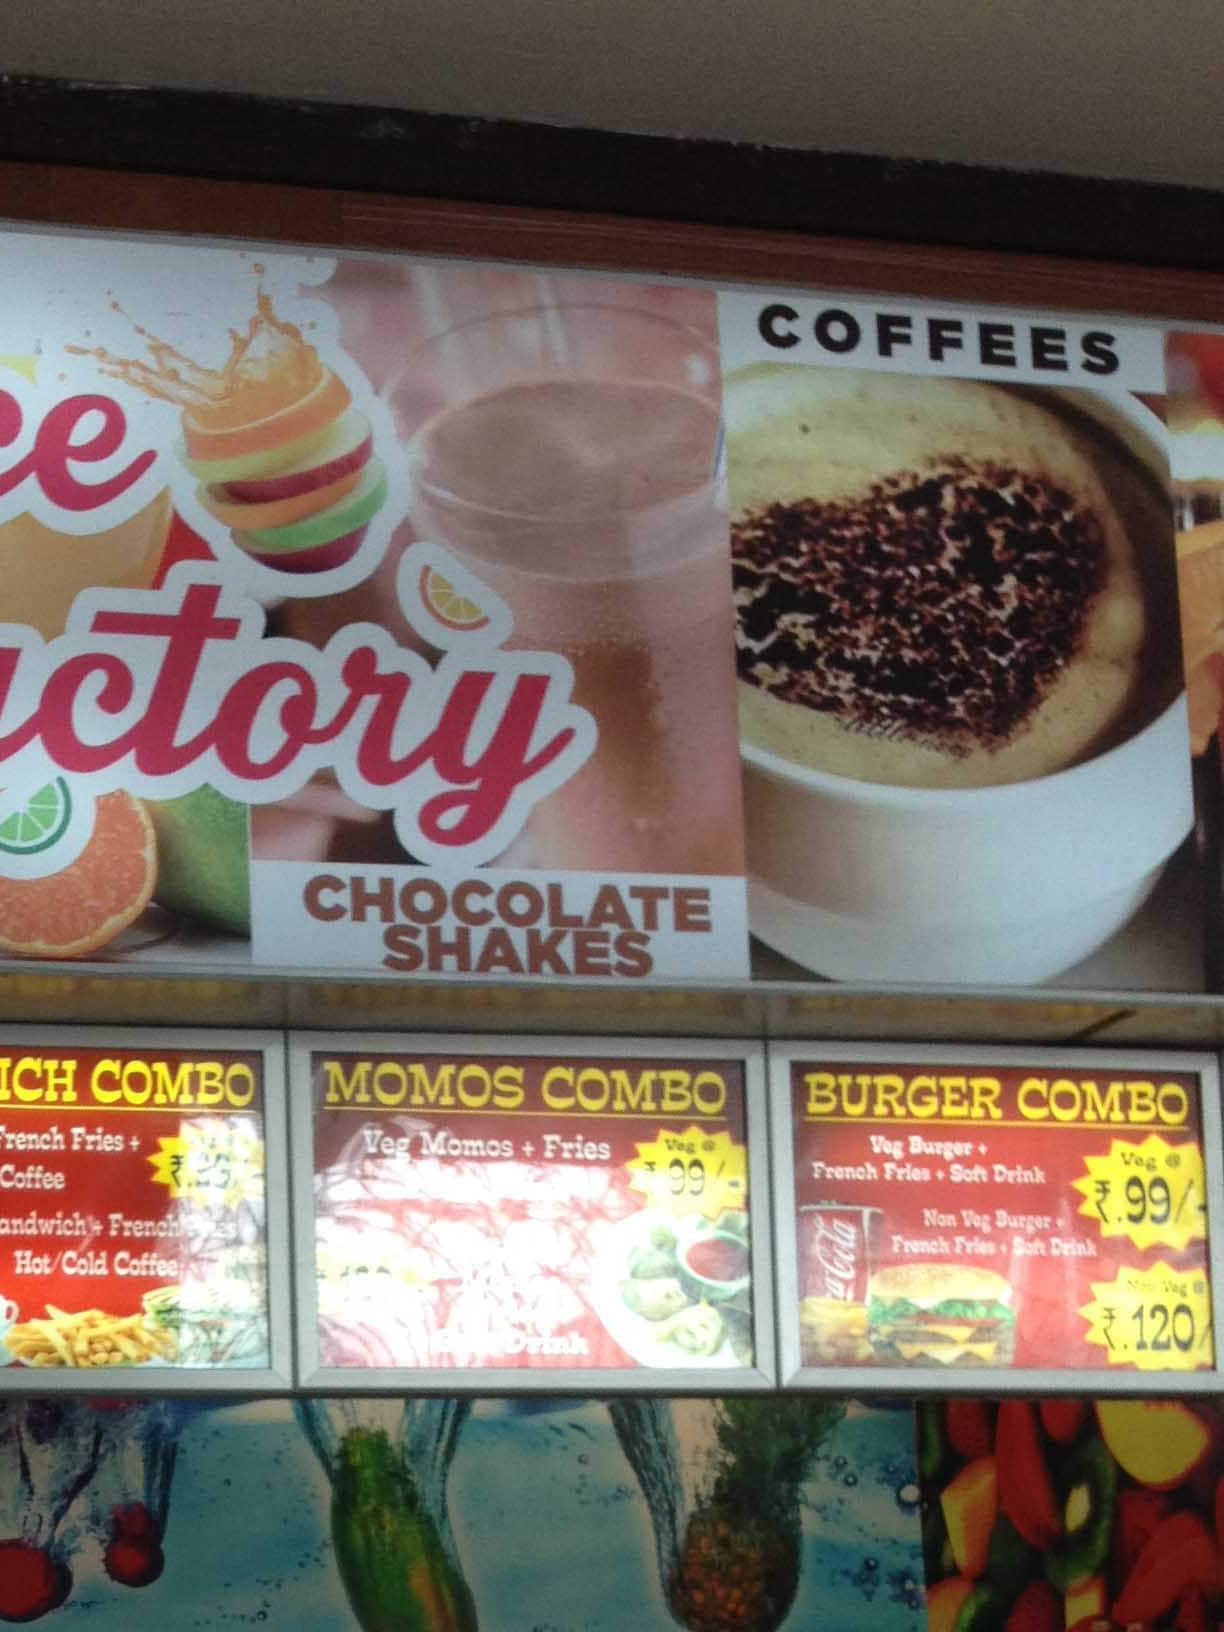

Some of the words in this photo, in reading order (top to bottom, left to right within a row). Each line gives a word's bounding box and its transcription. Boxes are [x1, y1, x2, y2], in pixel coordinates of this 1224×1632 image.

[757, 303, 1120, 376] COFFEES
[303, 874, 712, 933] CHOCOLATE
[381, 924, 654, 978] SHAKES
[90, 1059, 255, 1107] COMBO
[323, 1061, 525, 1108] MOMOS
[541, 1066, 727, 1115] COMBO
[804, 1072, 1003, 1120] BURGER
[1016, 1078, 1189, 1125] COMBO
[70, 1127, 125, 1151] Fries
[362, 1130, 412, 1162] Veg
[421, 1132, 514, 1158] Momos
[542, 1135, 612, 1160] Fries
[664, 1138, 696, 1154] Veg
[869, 1135, 904, 1160] Veg
[908, 1135, 973, 1161] Burger
[812, 1161, 878, 1180] French
[883, 1162, 931, 1182] Fries
[949, 1163, 988, 1183] Soft
[992, 1164, 1046, 1184] Drink
[1120, 1151, 1157, 1172] Veg
[109, 1213, 179, 1239] French
[922, 1208, 957, 1228] Non
[961, 1208, 991, 1233] Veg
[995, 1209, 1052, 1234] Burger
[891, 1235, 950, 1255] French
[954, 1236, 996, 1255] Fries
[13, 1250, 109, 1276] Hot/Cold
[114, 1252, 178, 1279] Coffee
